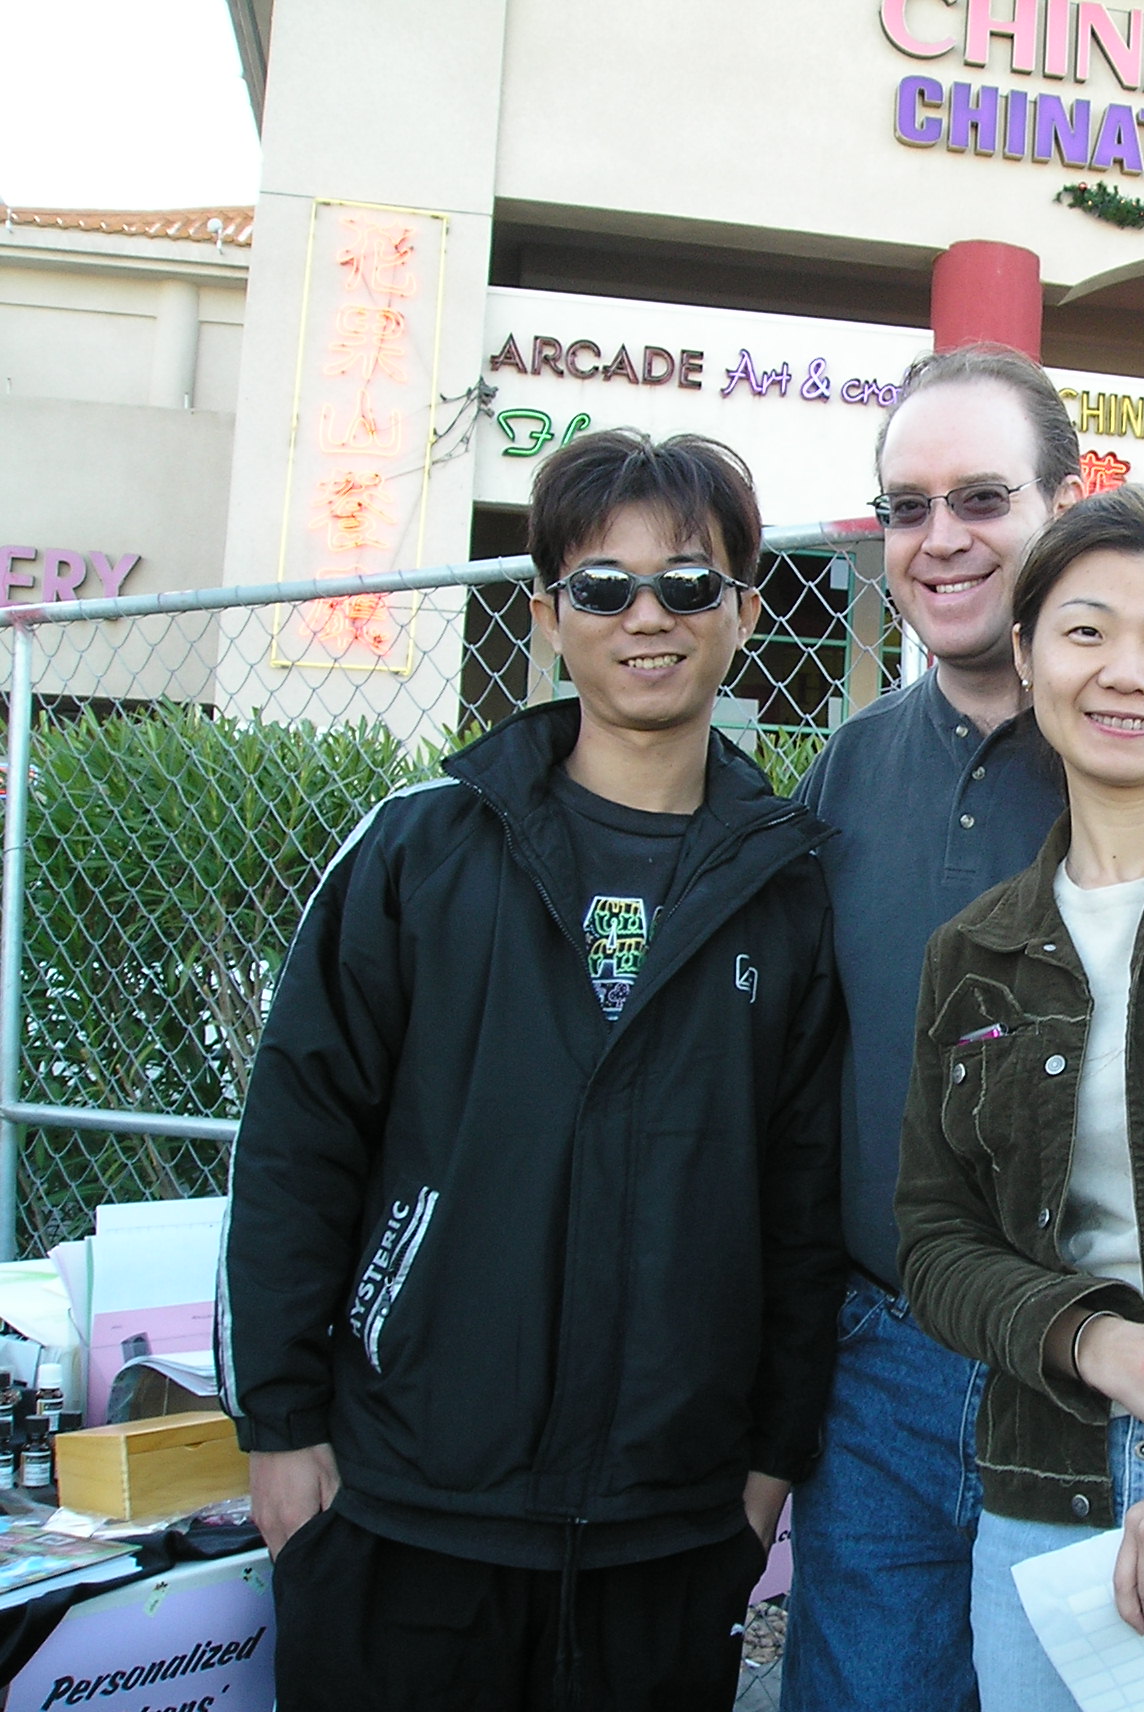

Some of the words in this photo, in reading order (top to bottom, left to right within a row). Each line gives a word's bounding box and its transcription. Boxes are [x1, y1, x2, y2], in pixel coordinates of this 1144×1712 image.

[489, 332, 704, 388] ARCADE
[721, 349, 791, 398] Art
[800, 358, 831, 403] &
[350, 1200, 410, 1338] HYSTERIC
[41, 1626, 268, 1711] Personalized
